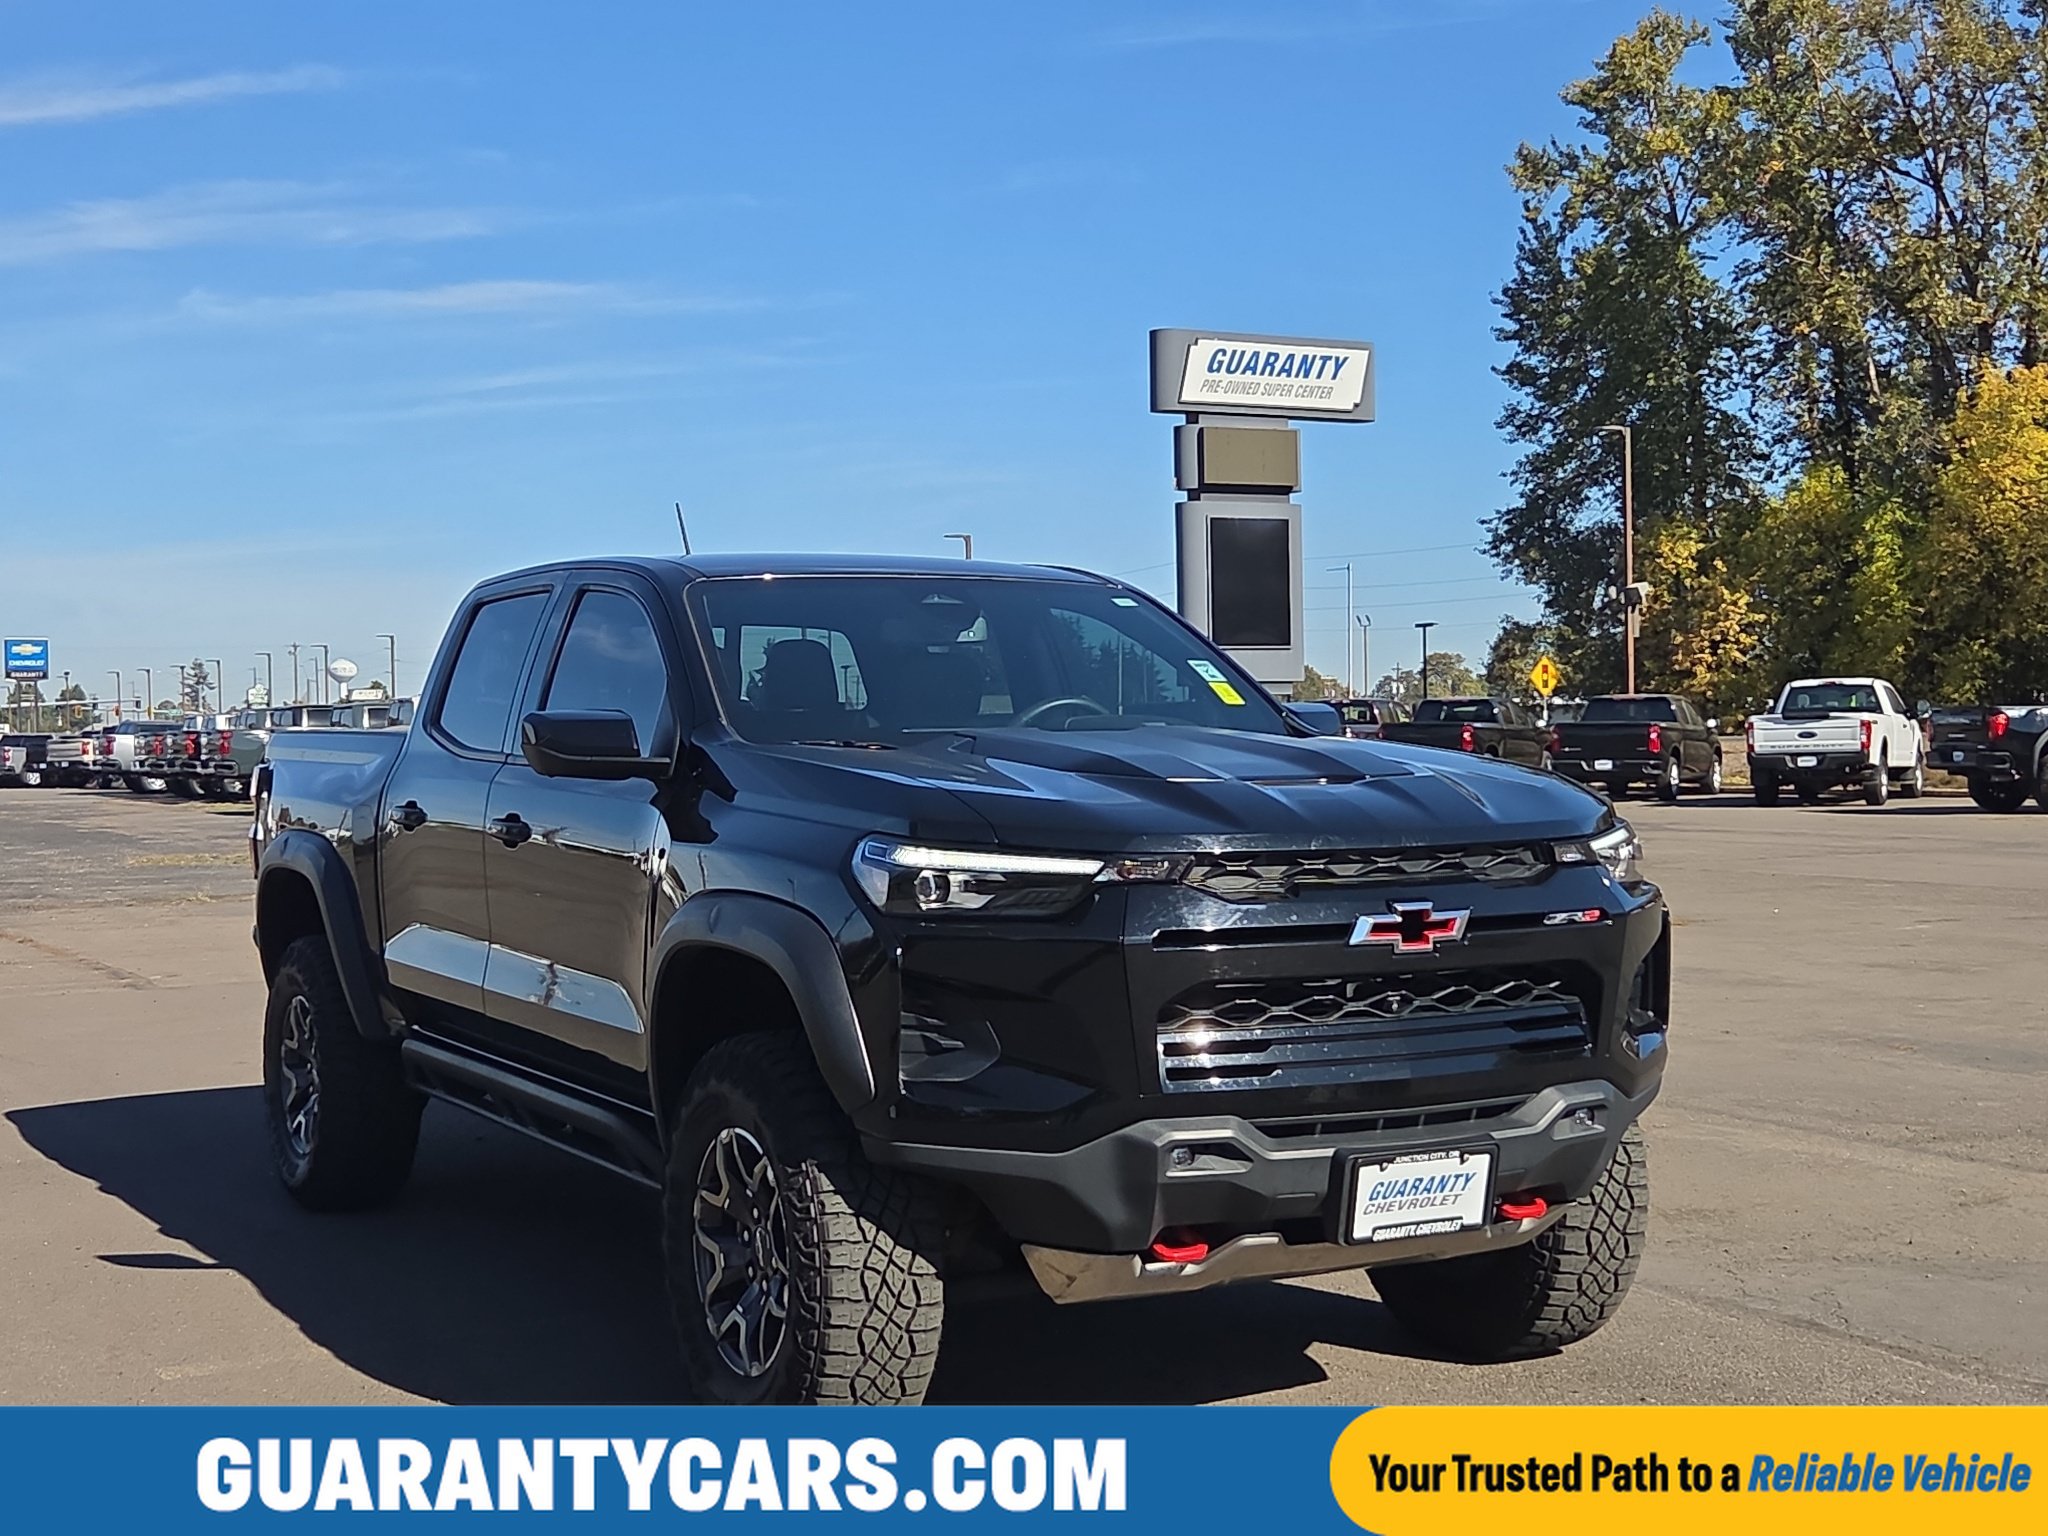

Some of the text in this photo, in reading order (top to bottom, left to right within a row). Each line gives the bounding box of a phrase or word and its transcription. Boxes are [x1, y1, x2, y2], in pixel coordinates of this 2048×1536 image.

[1206, 348, 1350, 380] GUARANTY
[1199, 379, 1334, 400] PRE-OWNED SUPER CENTER
[1393, 1153, 1430, 1164] JUNCTION
[1368, 1172, 1477, 1202] GUARANTY
[1363, 1193, 1463, 1216] CHEVROLET
[1372, 1219, 1463, 1242] GUARANTY CHEVROLET
